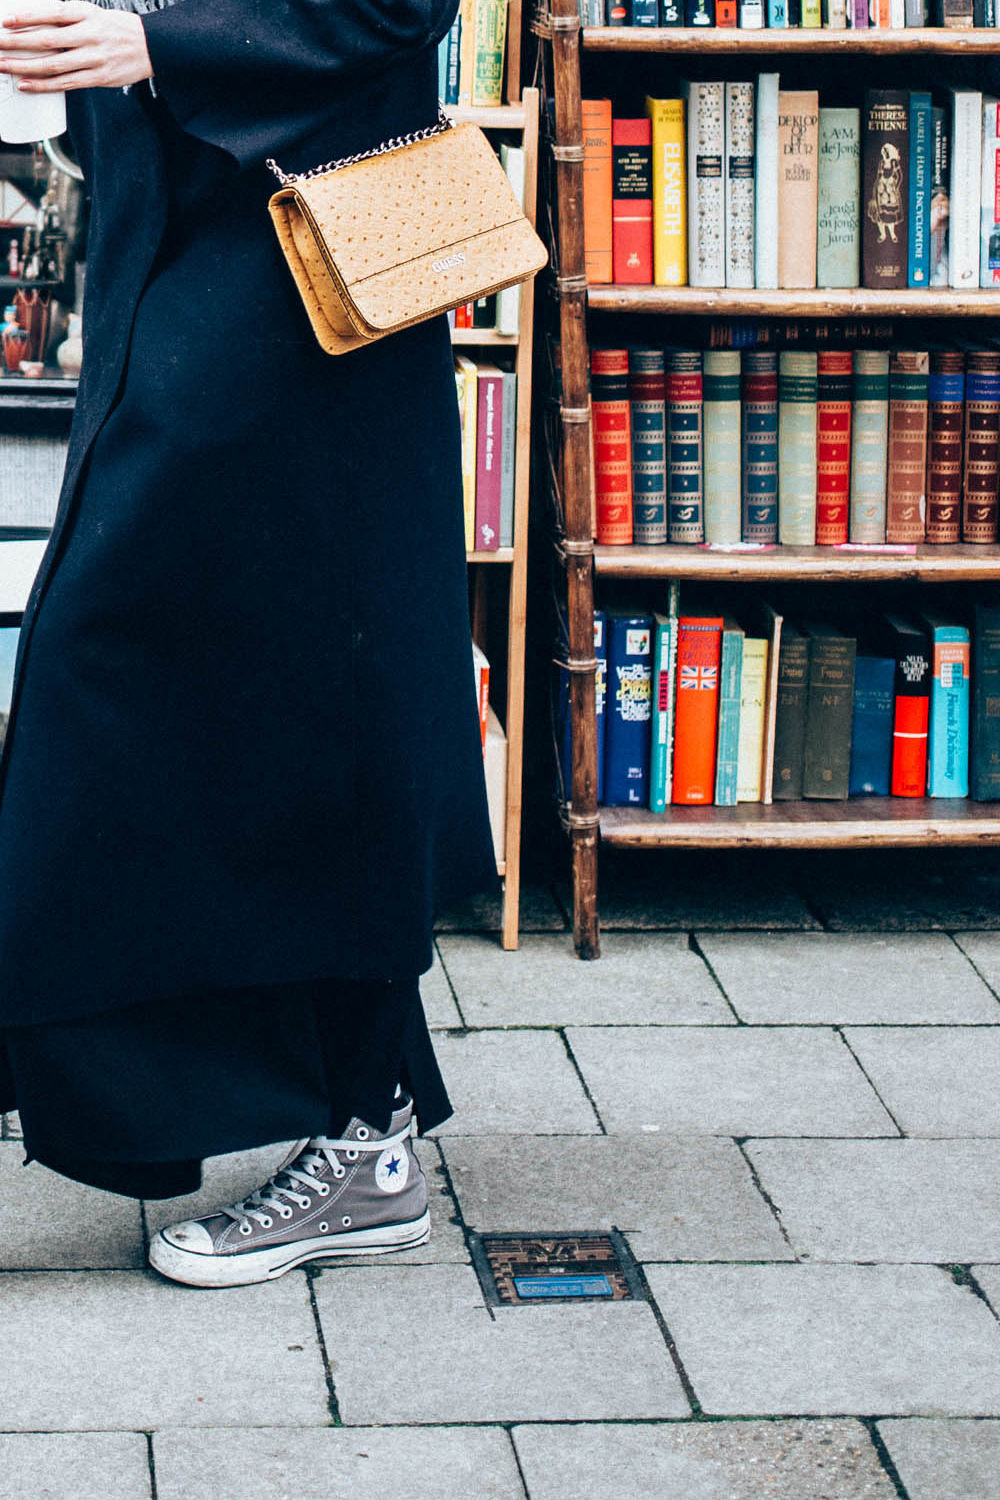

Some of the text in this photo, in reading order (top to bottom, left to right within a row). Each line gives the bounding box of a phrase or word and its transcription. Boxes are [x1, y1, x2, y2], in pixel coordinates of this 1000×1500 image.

[868, 120, 908, 132] ETIENNE
[869, 110, 908, 120] THERESE
[917, 111, 926, 144] LAUREL
[916, 155, 925, 188] HARDY
[431, 252, 465, 273] GUESS
[948, 692, 958, 726] French
